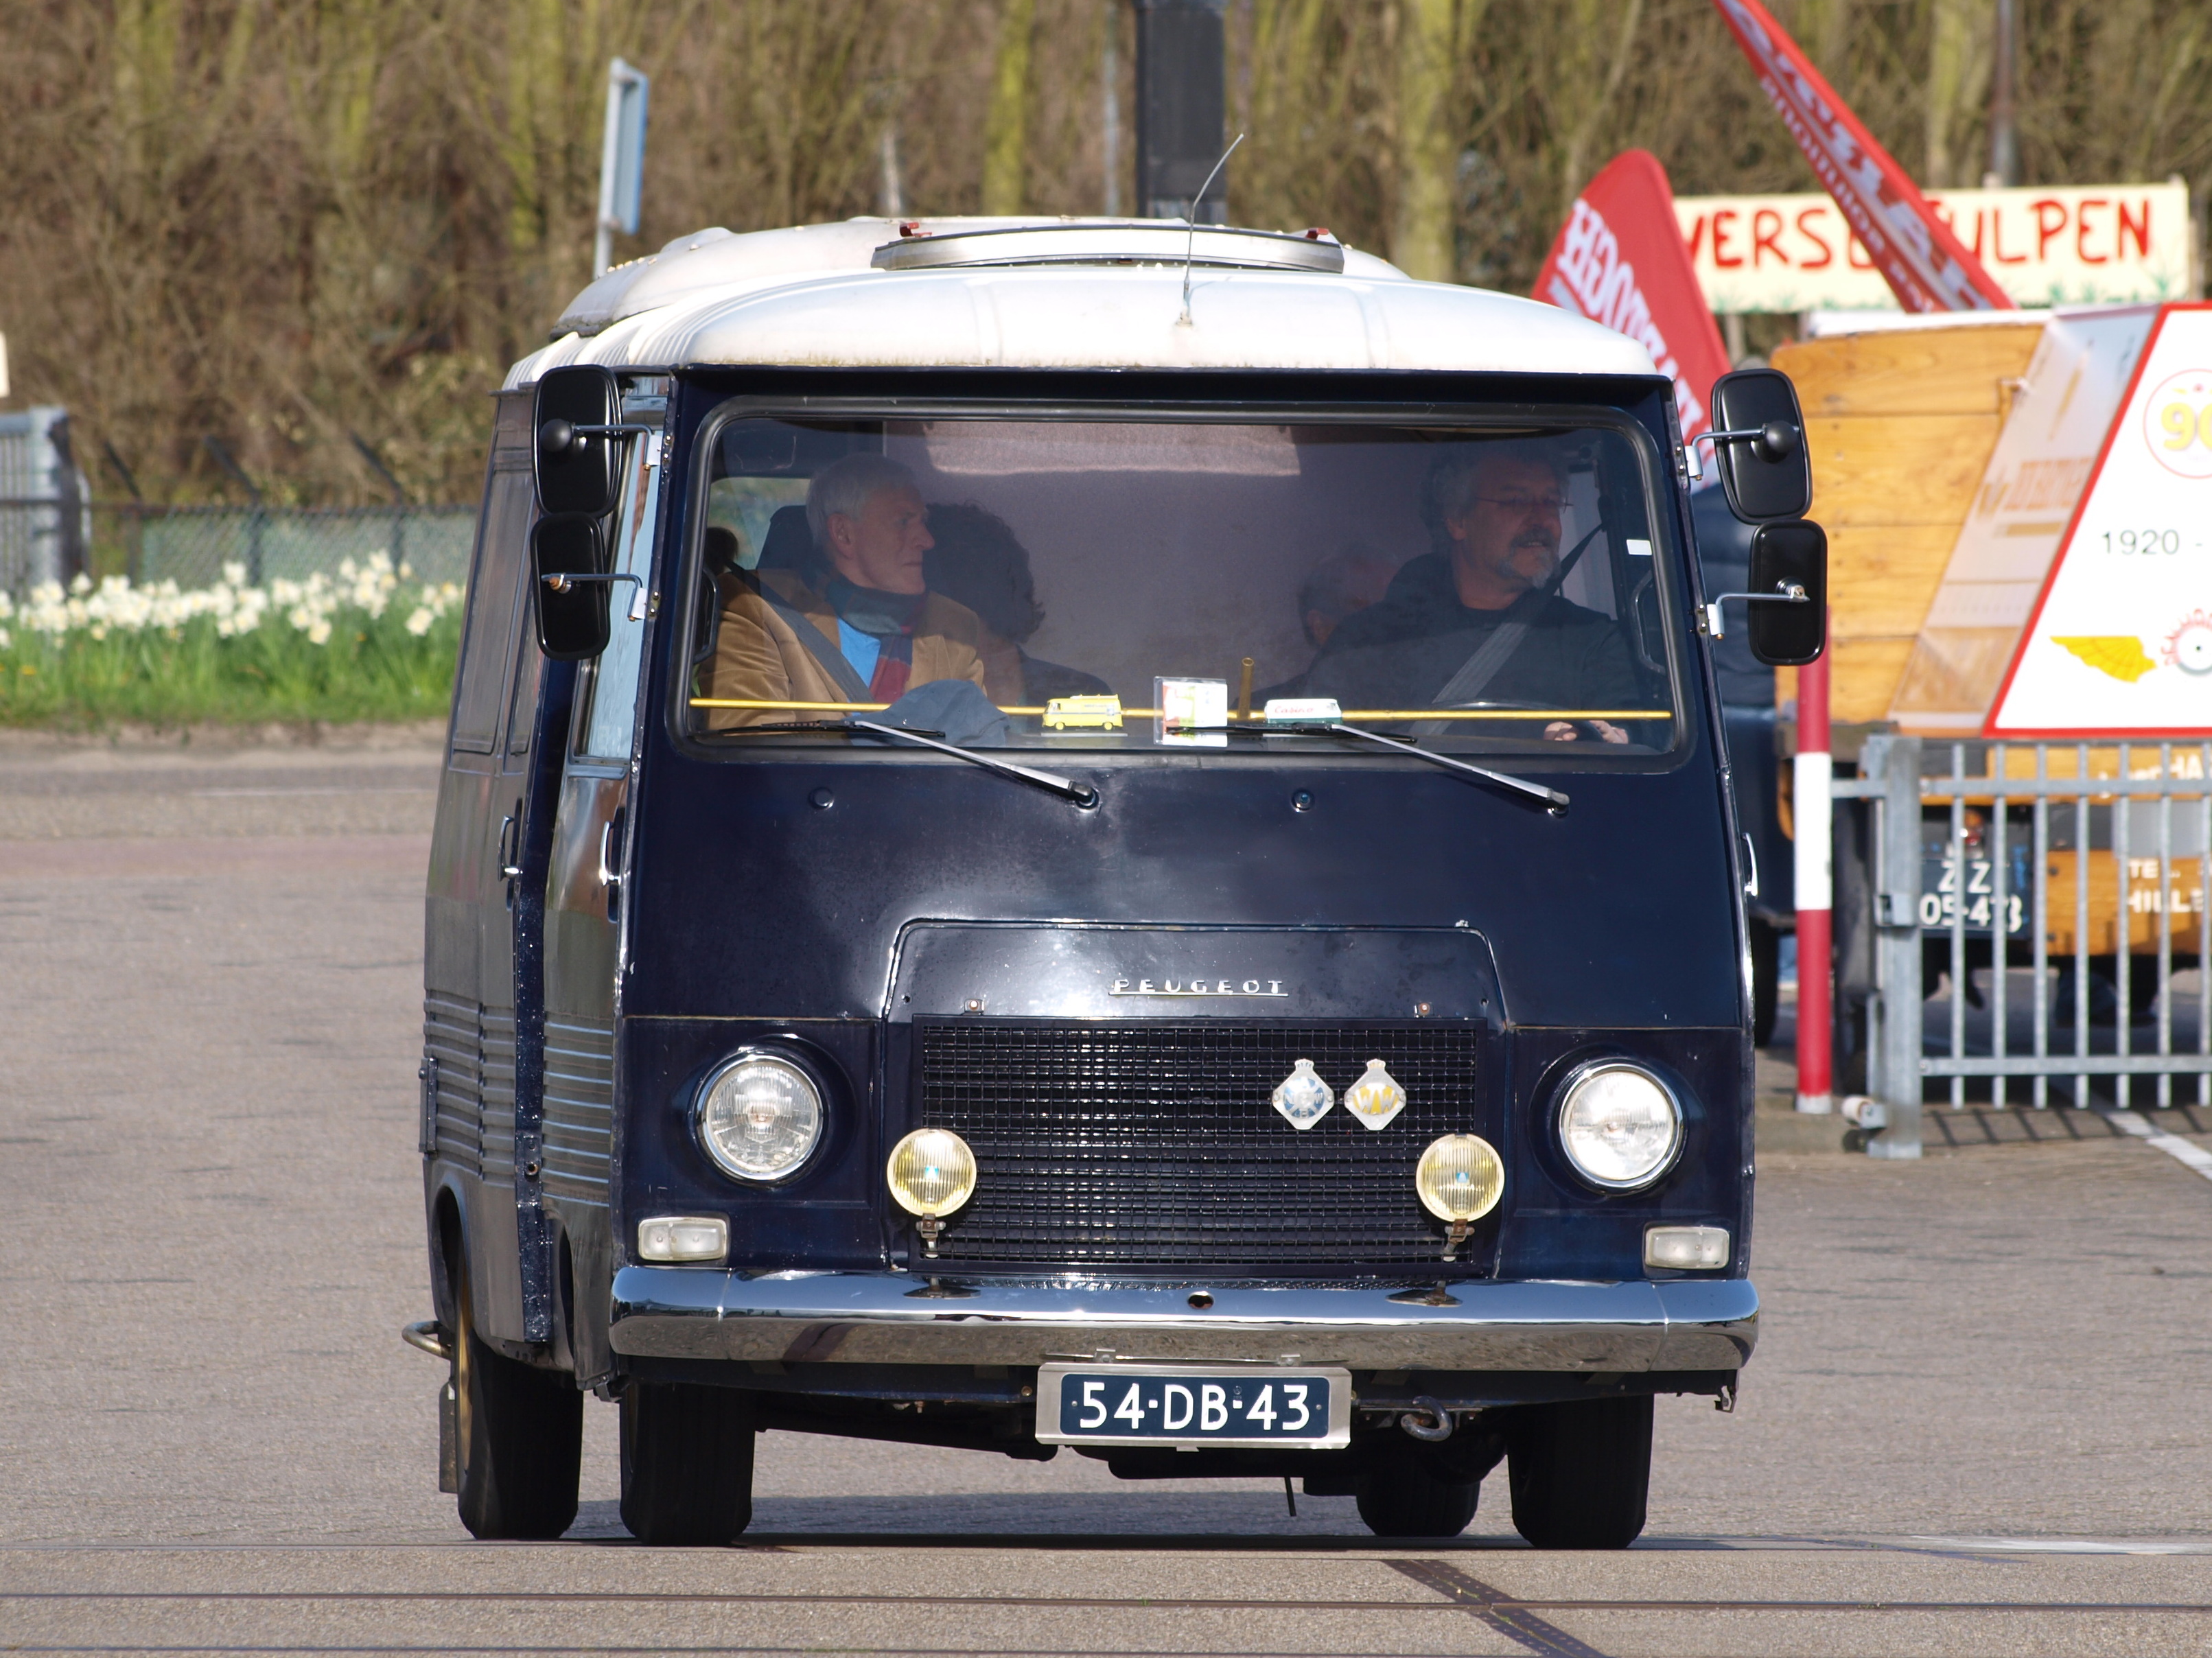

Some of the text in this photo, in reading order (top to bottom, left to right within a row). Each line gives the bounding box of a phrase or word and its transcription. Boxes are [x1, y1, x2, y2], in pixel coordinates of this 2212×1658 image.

[1924, 198, 2151, 265] ULPEN
[2102, 529, 2180, 555] 1920
[1274, 705, 1314, 714] Casino
[1113, 979, 1283, 994] PEUGEOT
